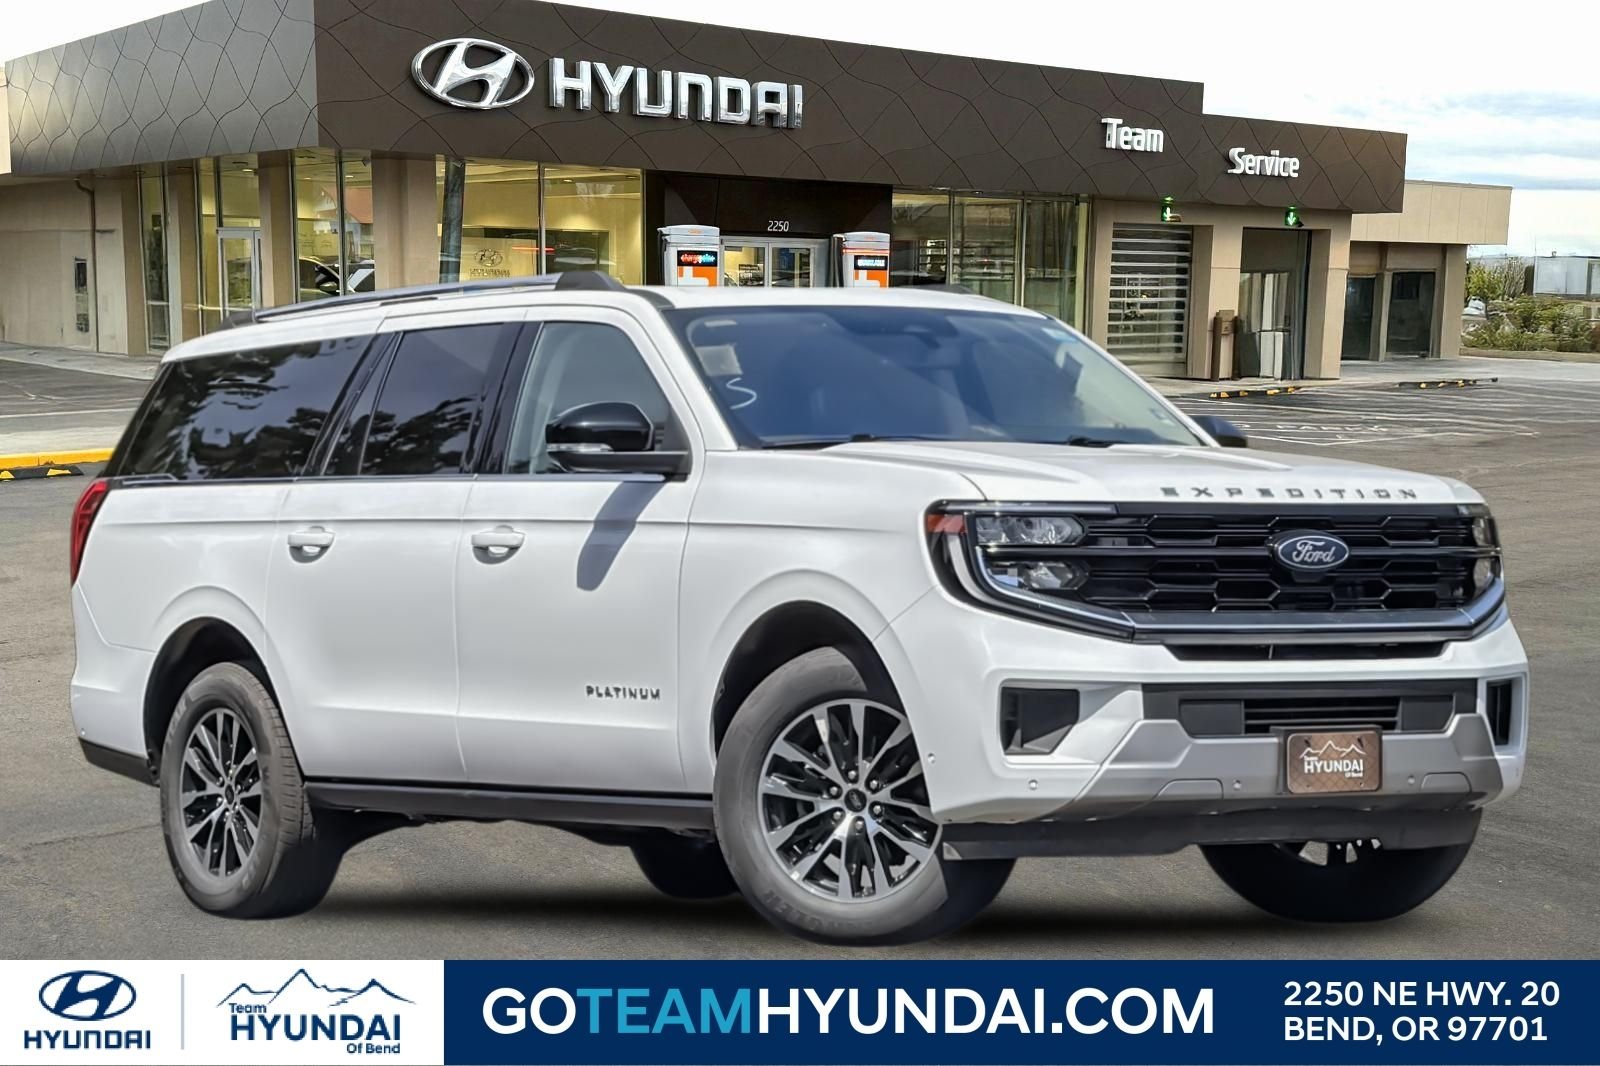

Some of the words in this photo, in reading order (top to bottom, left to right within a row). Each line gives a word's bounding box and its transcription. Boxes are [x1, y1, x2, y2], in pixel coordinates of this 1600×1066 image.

[549, 57, 803, 129] HYUNDAI
[1101, 117, 1164, 153] Team
[1227, 147, 1300, 178] Service
[767, 220, 790, 232] 2250
[1160, 487, 1418, 499] EXPEDITION
[1292, 540, 1336, 563] Ford
[586, 685, 661, 701] PLATINUM
[1304, 758, 1364, 774] HYUNDAI
